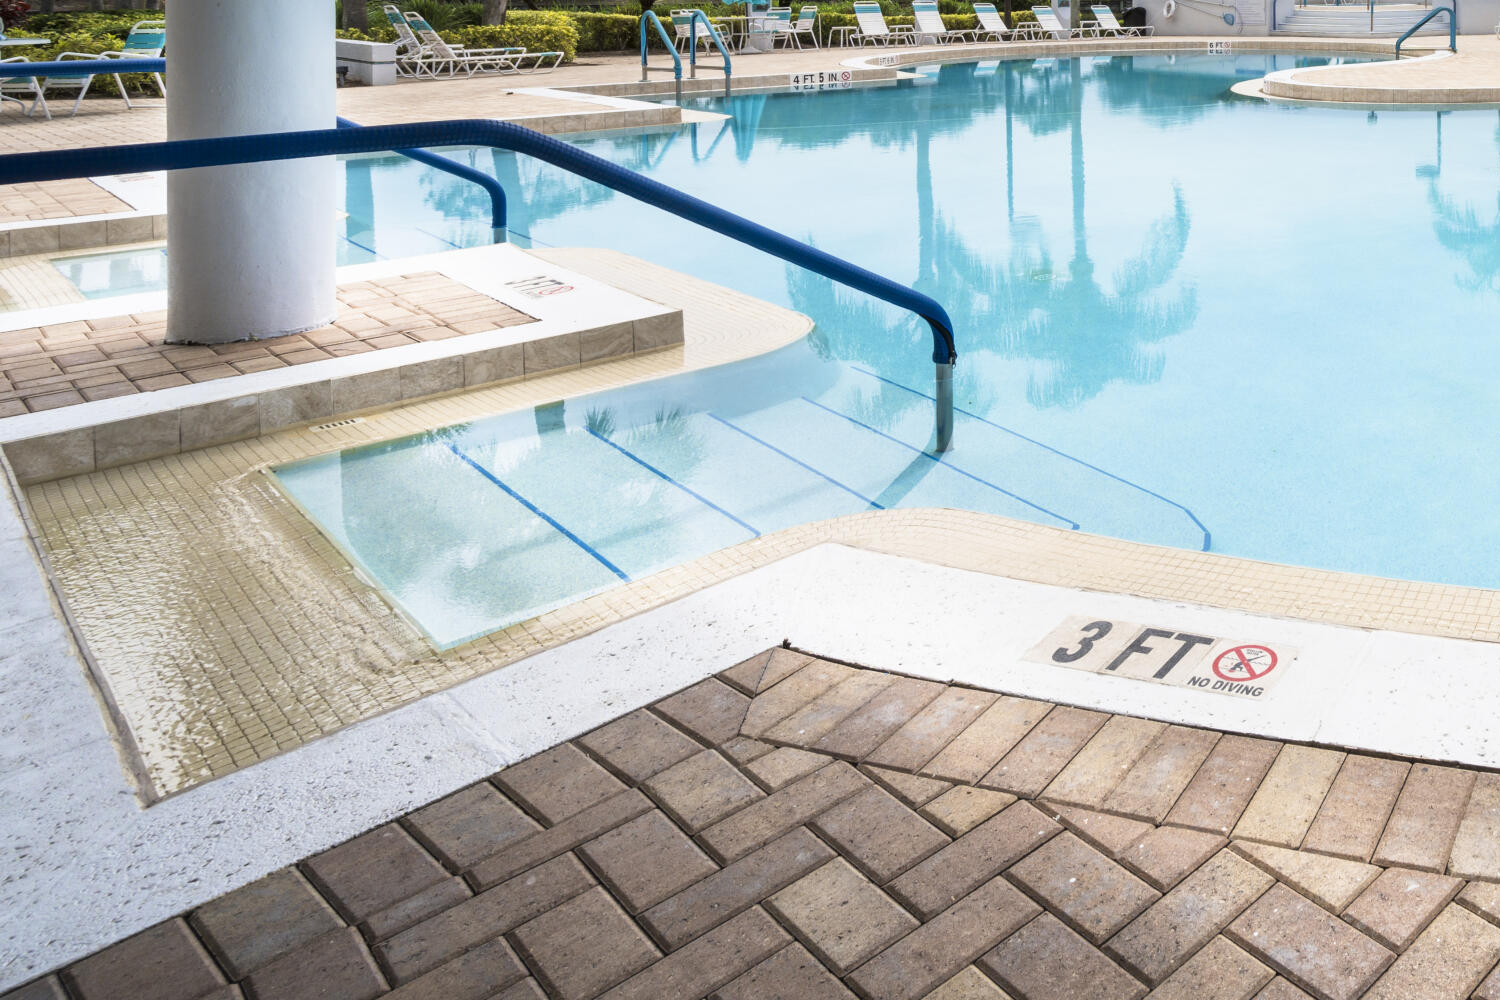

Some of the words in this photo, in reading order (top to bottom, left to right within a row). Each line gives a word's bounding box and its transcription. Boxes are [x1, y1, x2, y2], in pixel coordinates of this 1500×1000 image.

[793, 75, 800, 84] 4
[819, 72, 825, 83] 5
[1051, 620, 1113, 664] 3
[1105, 627, 1215, 680] FT
[1187, 676, 1211, 688] NO
[1211, 680, 1265, 697] DIVING
